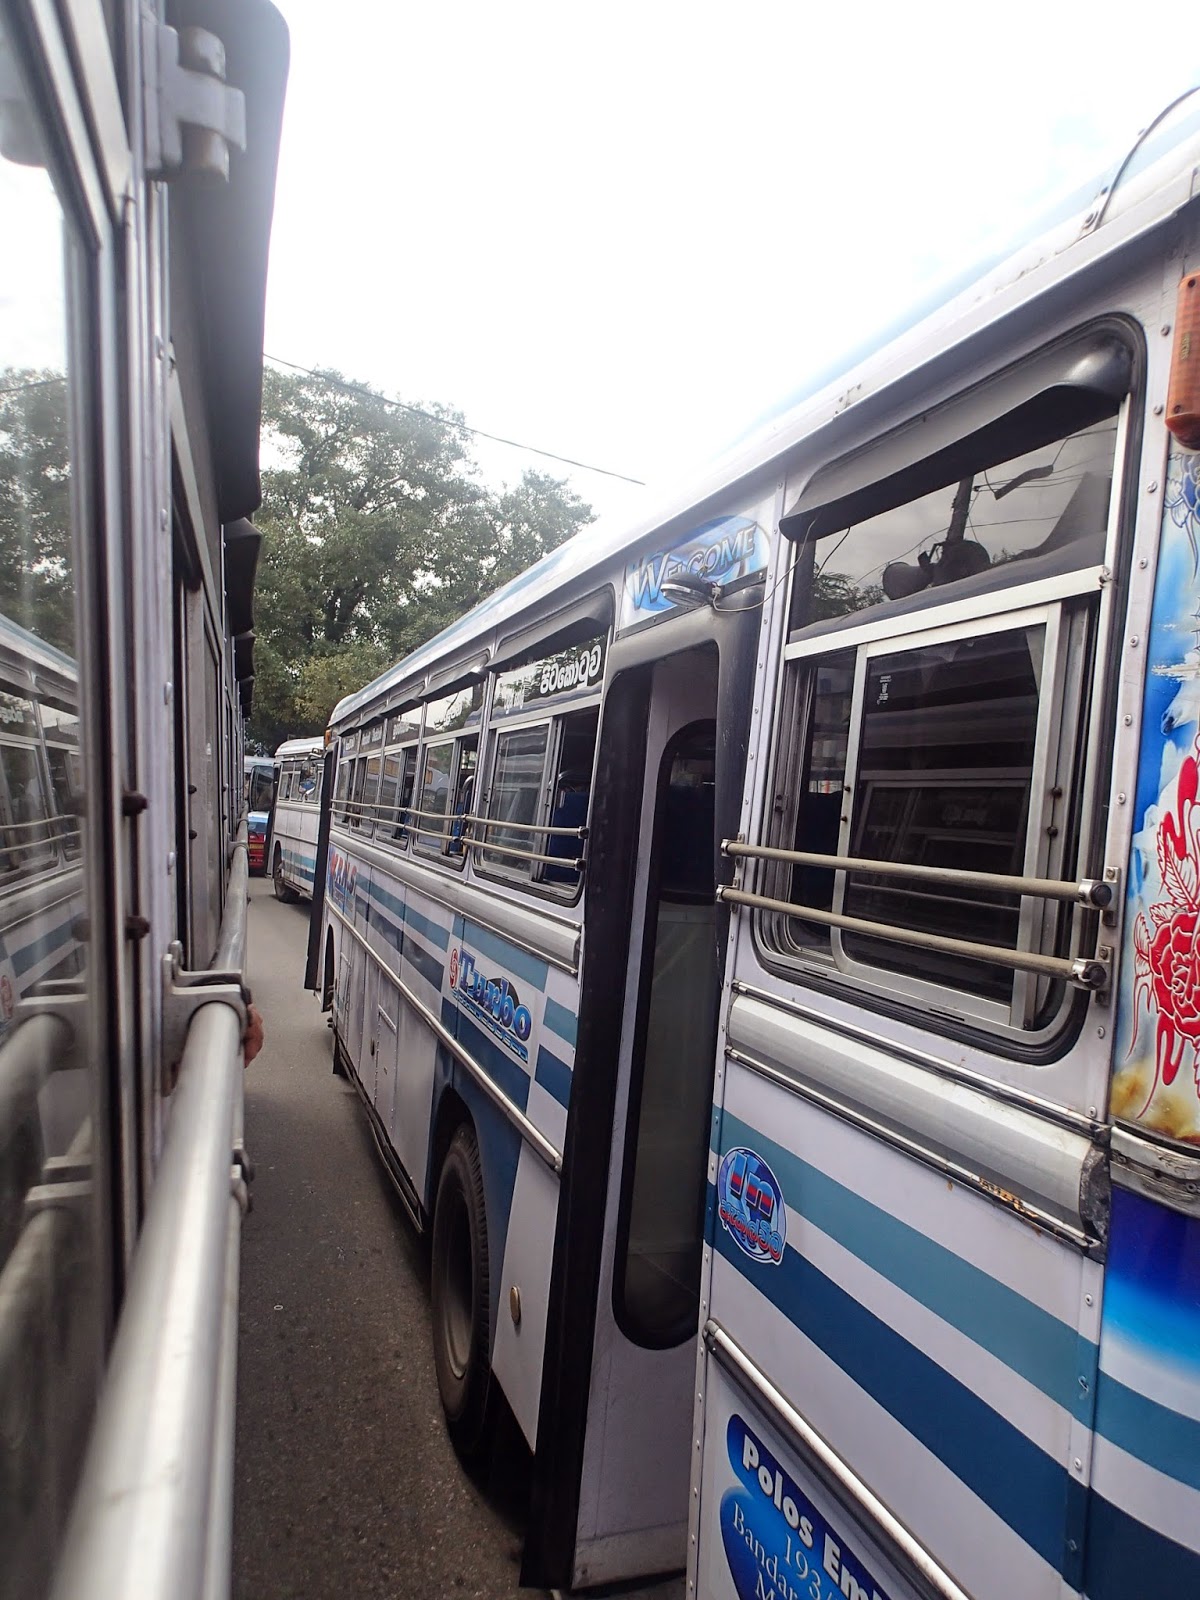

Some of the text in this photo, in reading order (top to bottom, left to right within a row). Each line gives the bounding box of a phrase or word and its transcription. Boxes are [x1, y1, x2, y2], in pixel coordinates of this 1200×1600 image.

[459, 947, 533, 1042] Turbo
[742, 1433, 883, 1600] Polos Em
